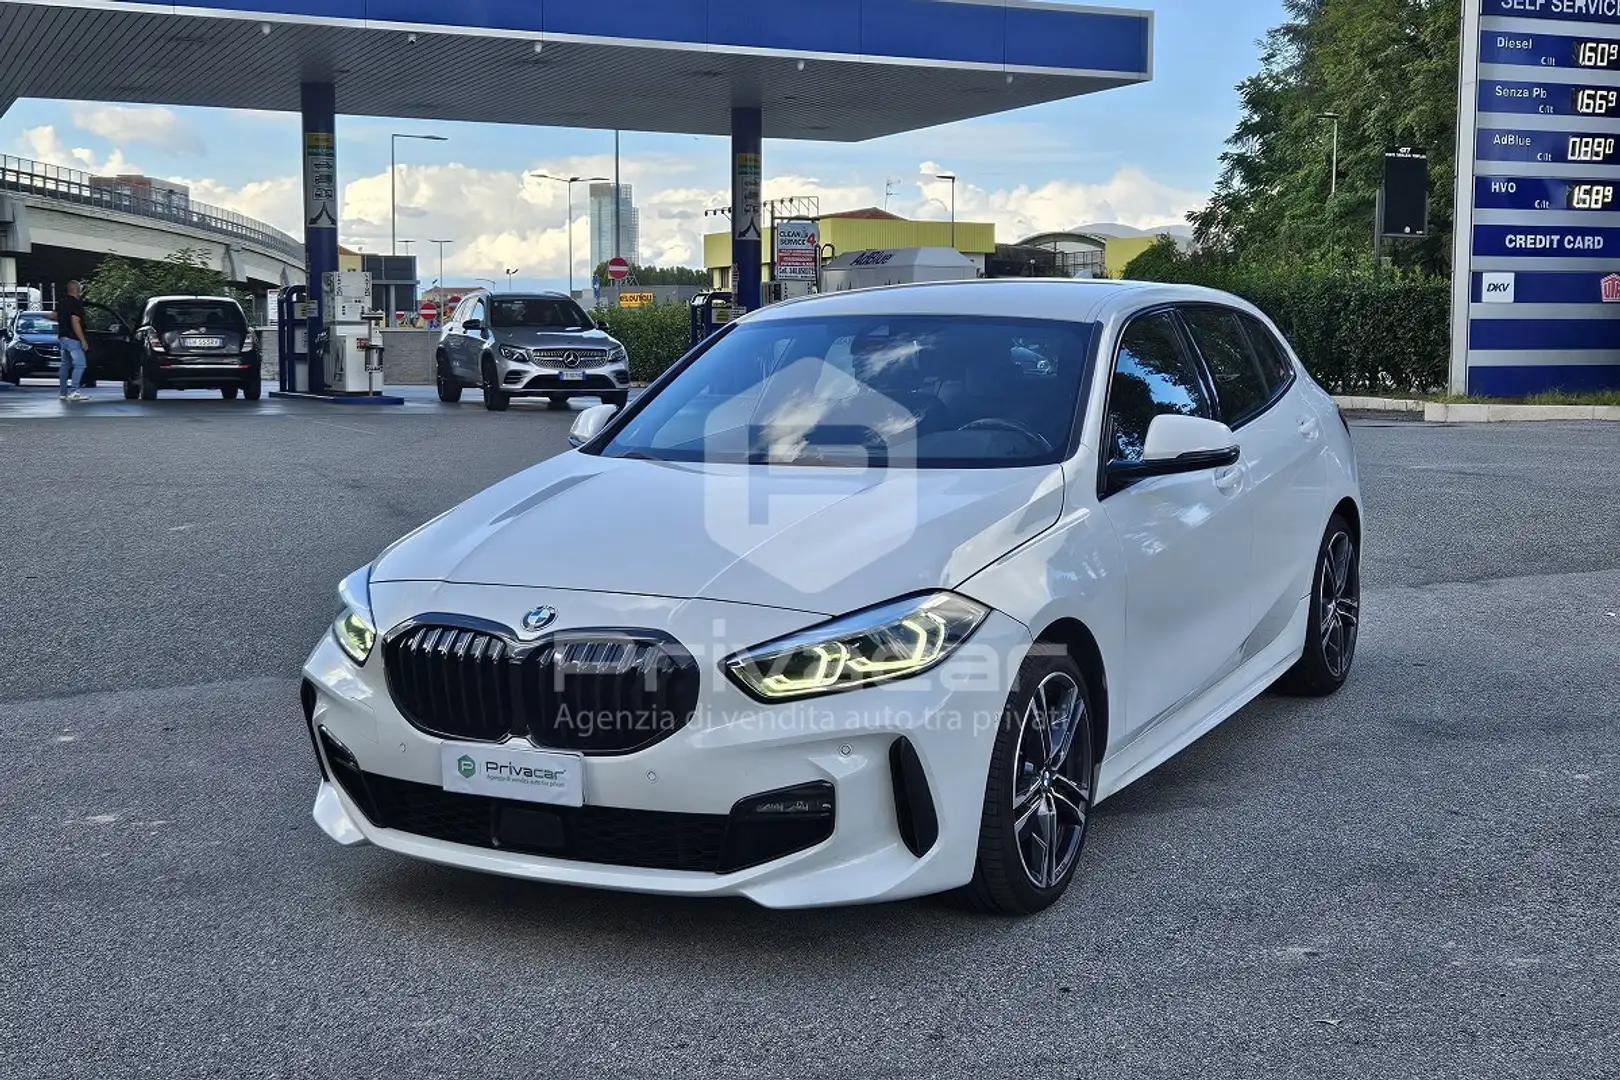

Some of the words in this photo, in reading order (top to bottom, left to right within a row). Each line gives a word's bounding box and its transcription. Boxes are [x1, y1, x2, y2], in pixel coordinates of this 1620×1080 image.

[1497, 37, 1532, 49] Diesel
[1495, 86, 1530, 97] Senza
[1533, 88, 1547, 99] Pb
[1493, 134, 1531, 146] AdBlue
[1491, 182, 1516, 193] HVO
[779, 230, 801, 238] CLEAN
[1505, 234, 1560, 249] CREDIT
[1564, 236, 1604, 249] CARD
[850, 250, 895, 266] AdBlue
[1487, 283, 1510, 292] DKV
[485, 761, 567, 781] Privacar
